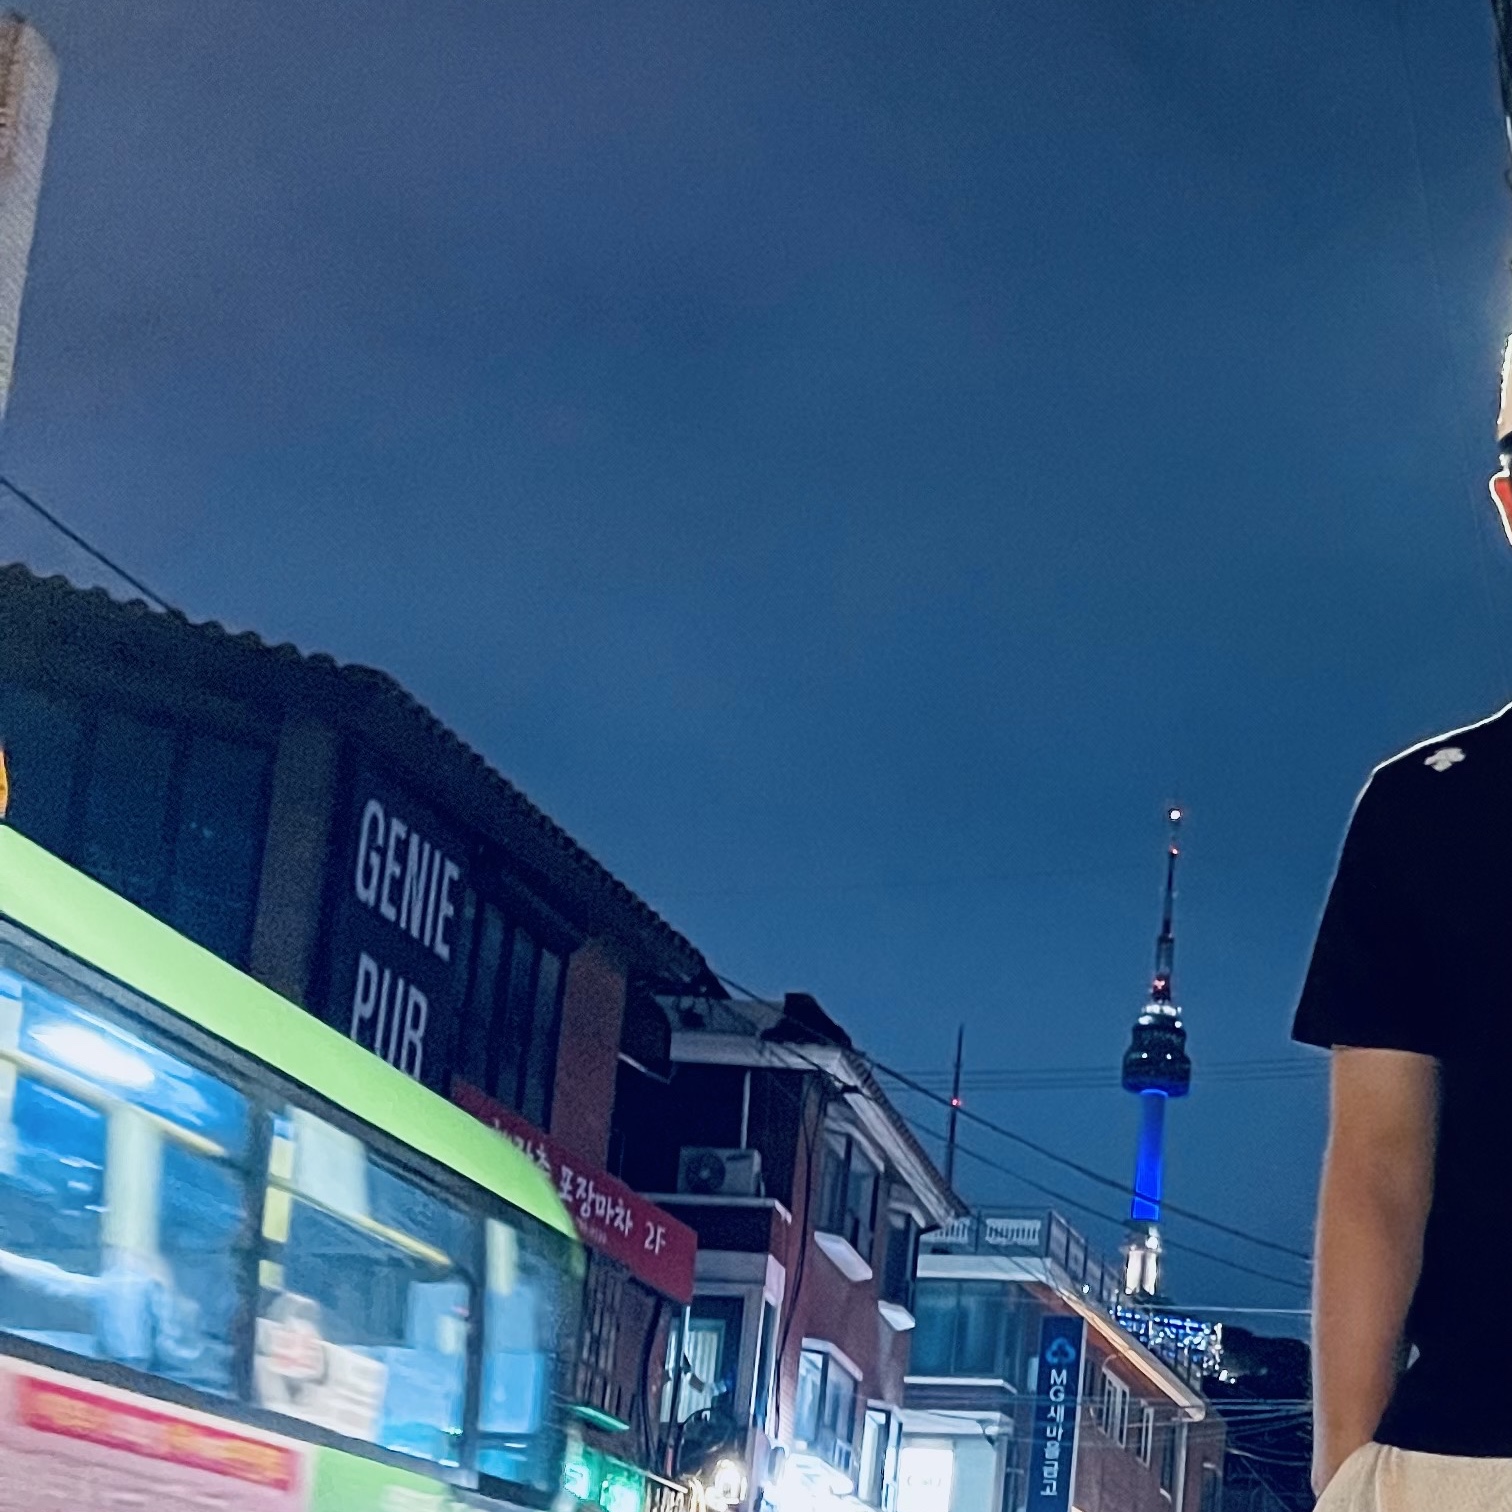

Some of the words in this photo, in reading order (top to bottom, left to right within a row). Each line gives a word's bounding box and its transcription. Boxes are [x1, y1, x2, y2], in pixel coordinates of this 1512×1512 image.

[355, 799, 460, 962] GENIE
[351, 951, 428, 1082] PUB
[559, 1165, 633, 1237] 포장마차
[643, 1221, 666, 1255] 2F
[1040, 1368, 1068, 1496] MG새마을금고
